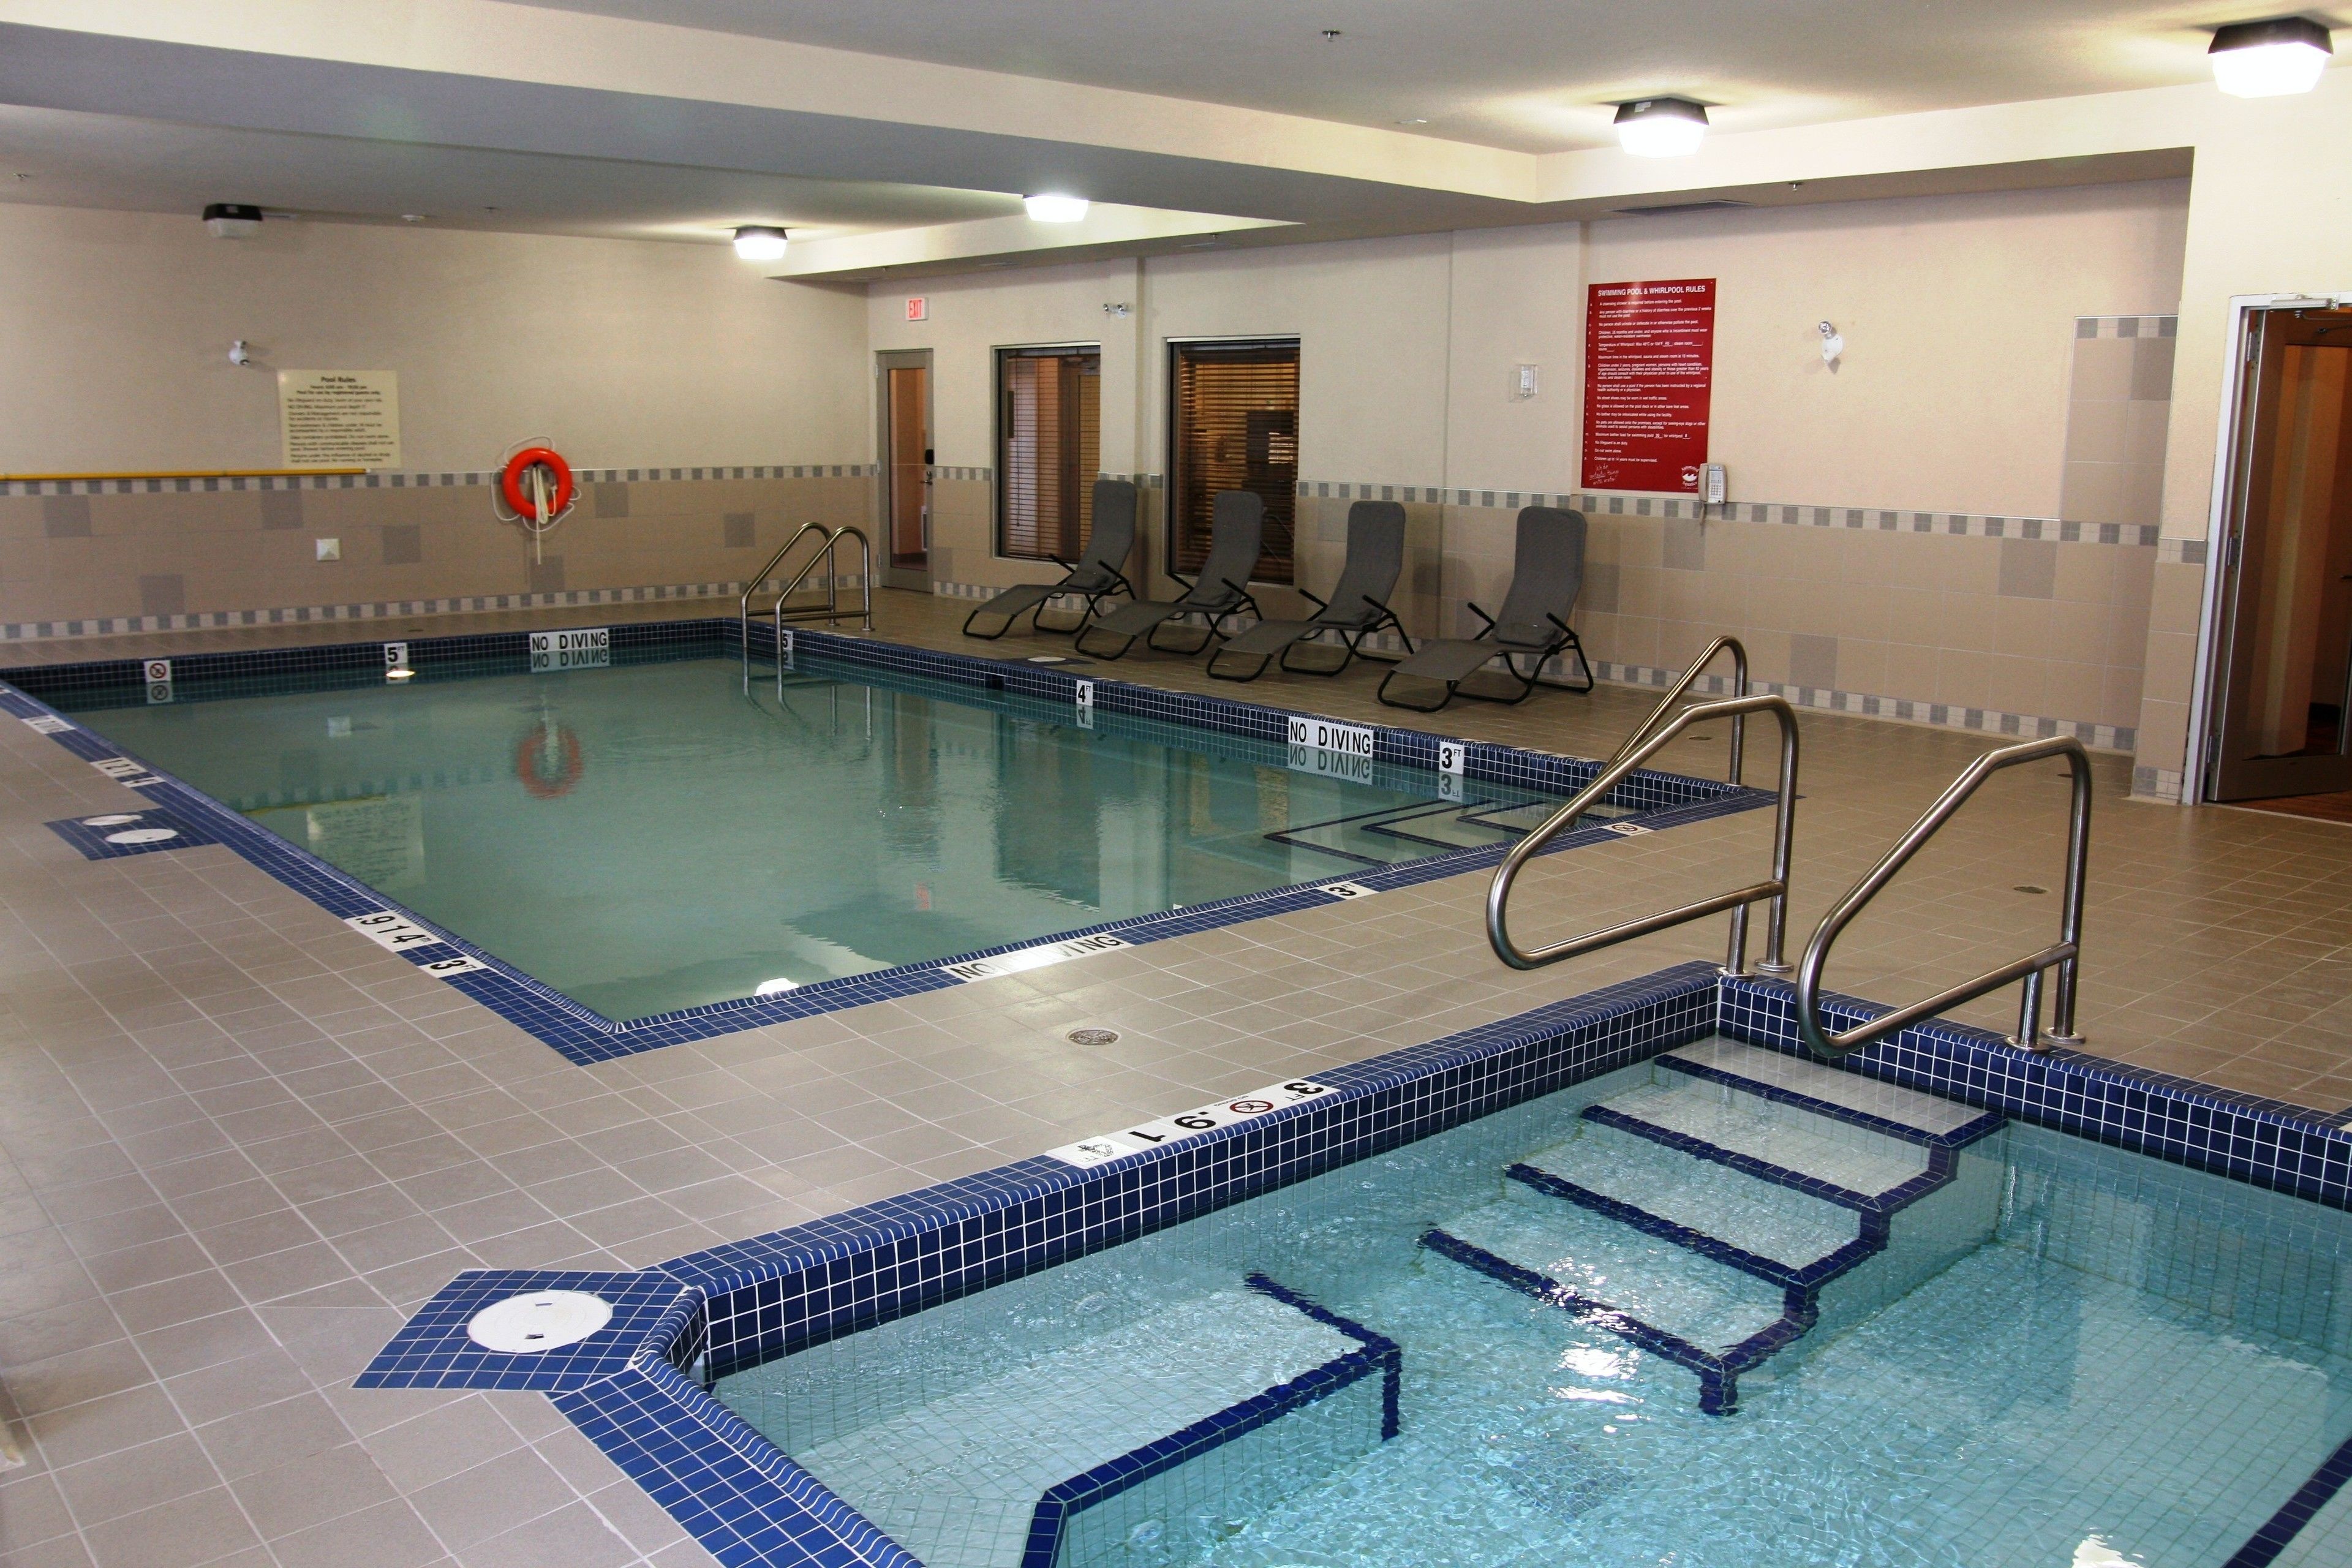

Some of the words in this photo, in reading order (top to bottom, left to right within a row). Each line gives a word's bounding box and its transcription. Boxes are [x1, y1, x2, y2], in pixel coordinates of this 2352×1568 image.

[909, 300, 922, 317] EXIT
[532, 636, 548, 651] NO
[559, 632, 607, 649] DIVING
[783, 633, 788, 648] 5
[388, 647, 398, 662] 5
[1078, 685, 1086, 703] 4
[1290, 721, 1306, 742] NO
[1319, 726, 1371, 754] DIVING
[1441, 748, 1452, 769] 3
[1329, 887, 1357, 896] 3
[430, 960, 467, 970] 3
[1284, 1082, 1324, 1095] 3
